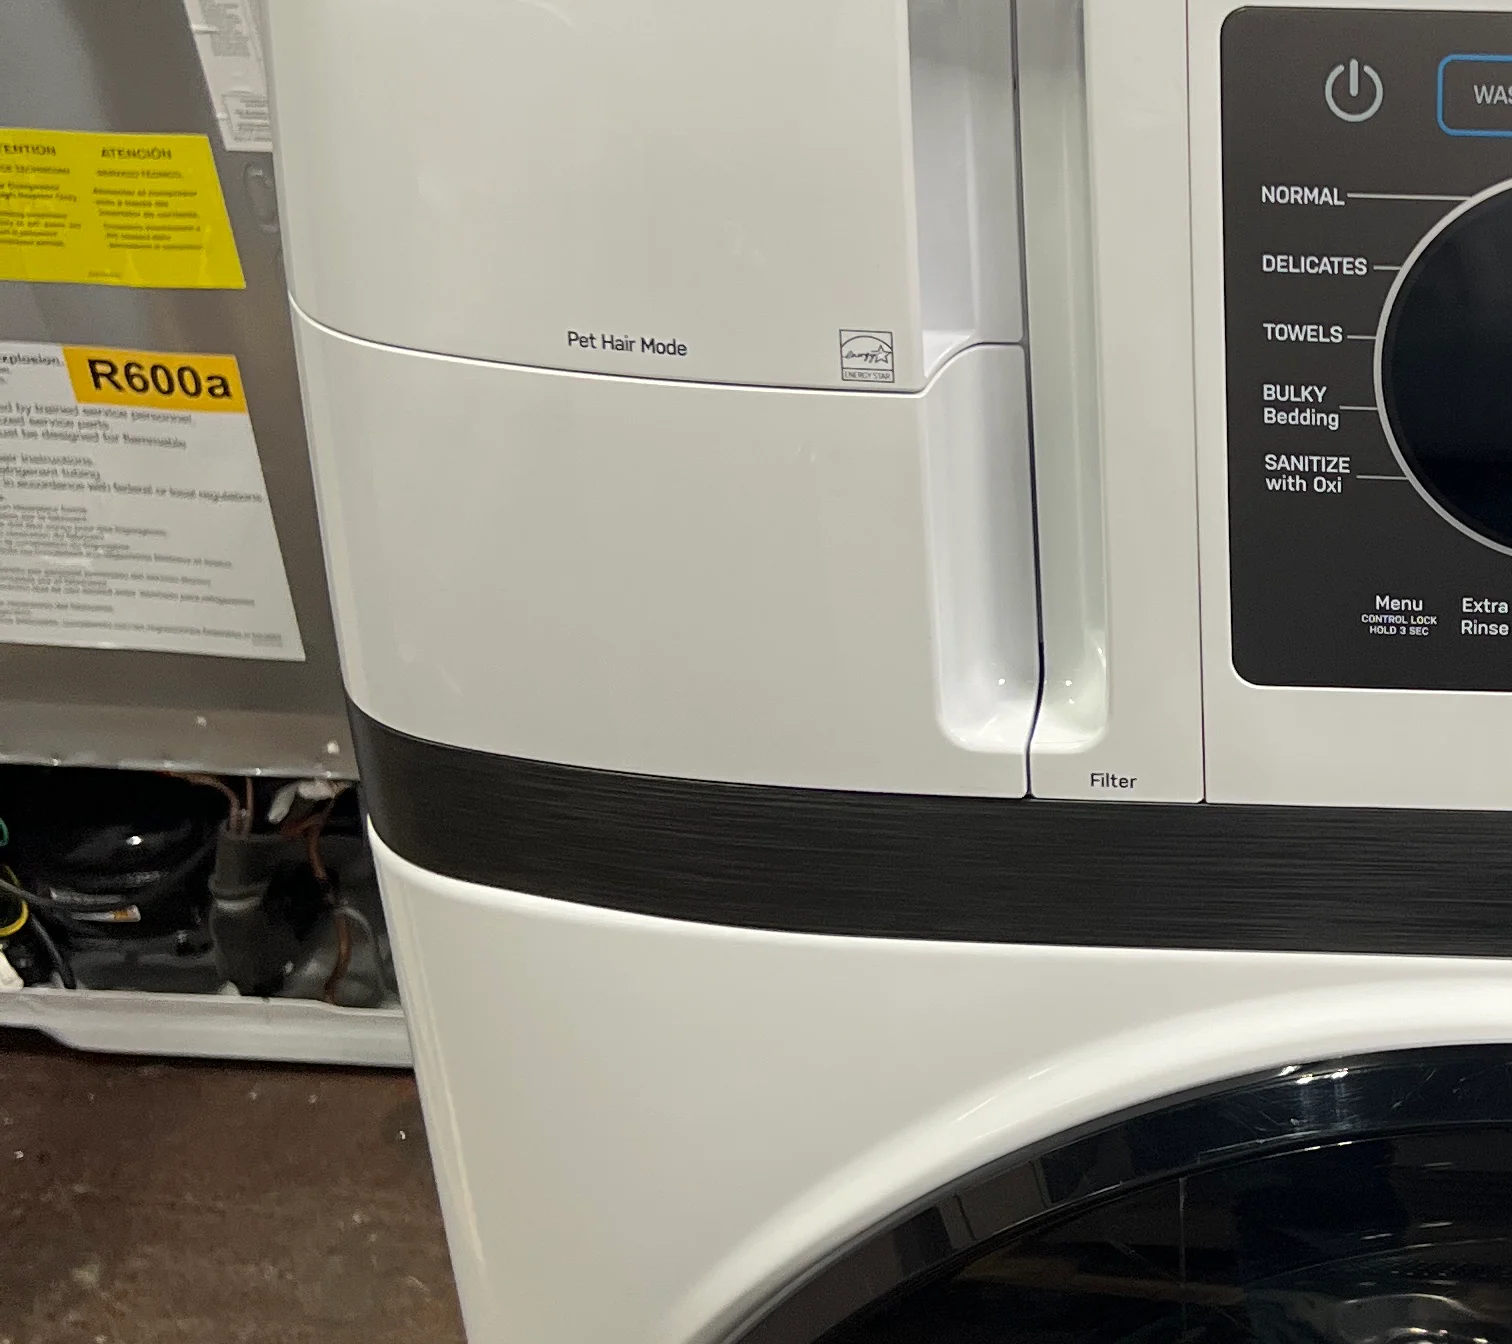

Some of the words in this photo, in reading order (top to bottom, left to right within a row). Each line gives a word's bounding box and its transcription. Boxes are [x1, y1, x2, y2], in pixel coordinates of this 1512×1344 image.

[1260, 185, 1346, 206] NORMAL
[1261, 254, 1368, 275] DELICATES
[1262, 322, 1344, 344] TOWELS
[567, 330, 597, 349] Pet
[601, 333, 636, 353] Hair
[641, 337, 688, 357] Mode
[88, 358, 233, 400] R600a
[1262, 383, 1327, 403] BULKY
[1263, 407, 1340, 431] Bedding
[1264, 454, 1351, 474] SANITIZE
[1265, 474, 1307, 492] with
[1313, 475, 1343, 494] Oxi
[1375, 594, 1424, 612] Menu
[1461, 597, 1509, 614] Extra
[1361, 614, 1408, 625] CONTROL
[1410, 615, 1438, 626] LOCK
[1460, 619, 1510, 636] Rinse
[1369, 625, 1397, 636] HOLD
[1399, 626, 1407, 636] 3
[1409, 626, 1430, 637] SEC
[1090, 772, 1138, 789] Filter
